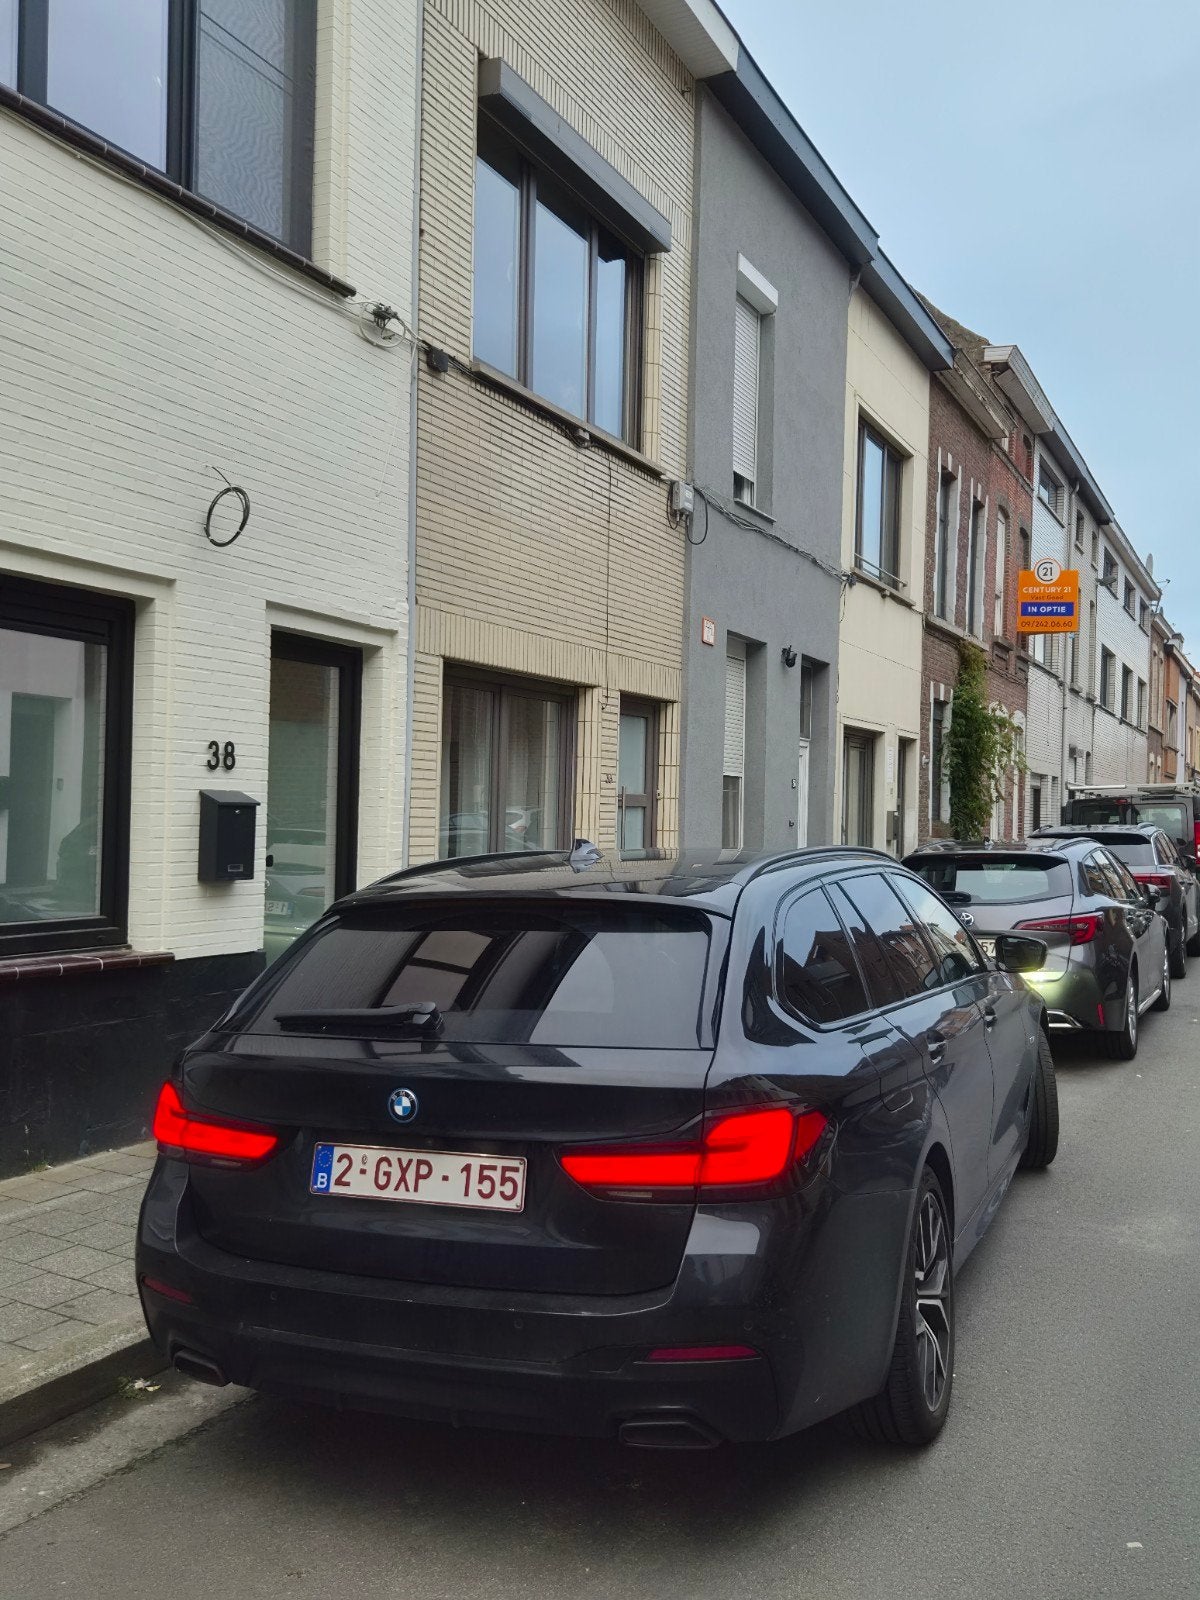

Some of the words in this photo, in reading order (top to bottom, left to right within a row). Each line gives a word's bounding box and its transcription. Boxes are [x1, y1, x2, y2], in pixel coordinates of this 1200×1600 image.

[1022, 586, 1062, 594] CENTURY
[1021, 620, 1073, 628] 09/242.06.60
[206, 740, 236, 771] 38
[316, 1172, 328, 1189] B
